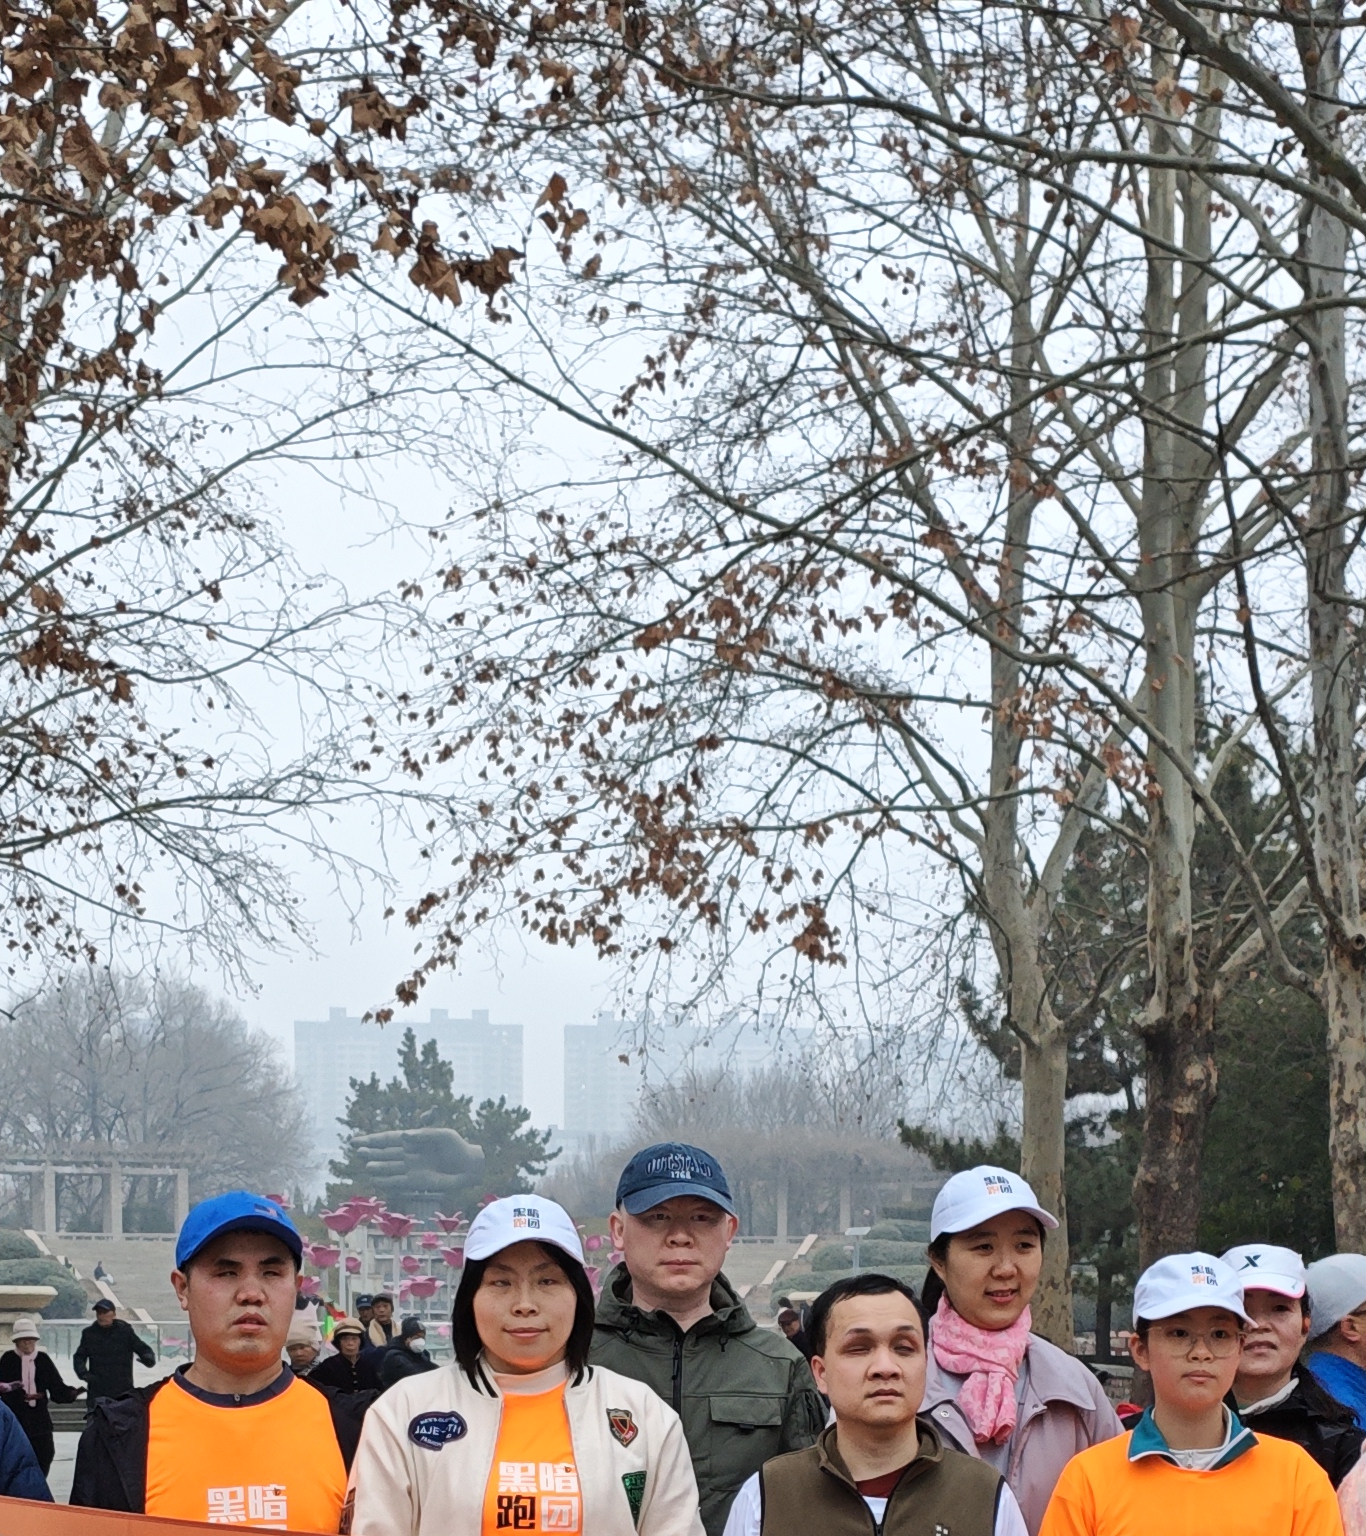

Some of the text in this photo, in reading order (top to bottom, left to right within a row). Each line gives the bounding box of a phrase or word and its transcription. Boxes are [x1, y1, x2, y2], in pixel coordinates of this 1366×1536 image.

[498, 1461, 579, 1493] 黑暗
[207, 1484, 288, 1523] 黑暗
[496, 1494, 579, 1532] 跑团
